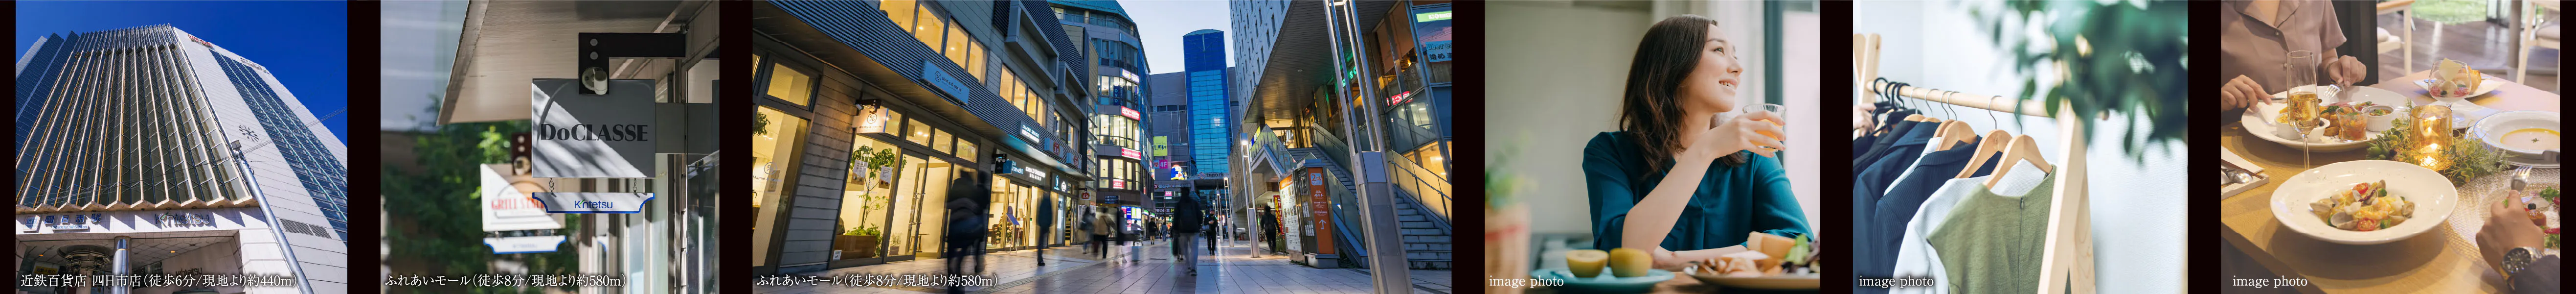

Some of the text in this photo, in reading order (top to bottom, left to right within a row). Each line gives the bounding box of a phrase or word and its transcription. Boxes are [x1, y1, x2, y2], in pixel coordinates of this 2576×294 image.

[540, 123, 648, 142] DoCLASSE
[45, 213, 101, 224] 四日市駅
